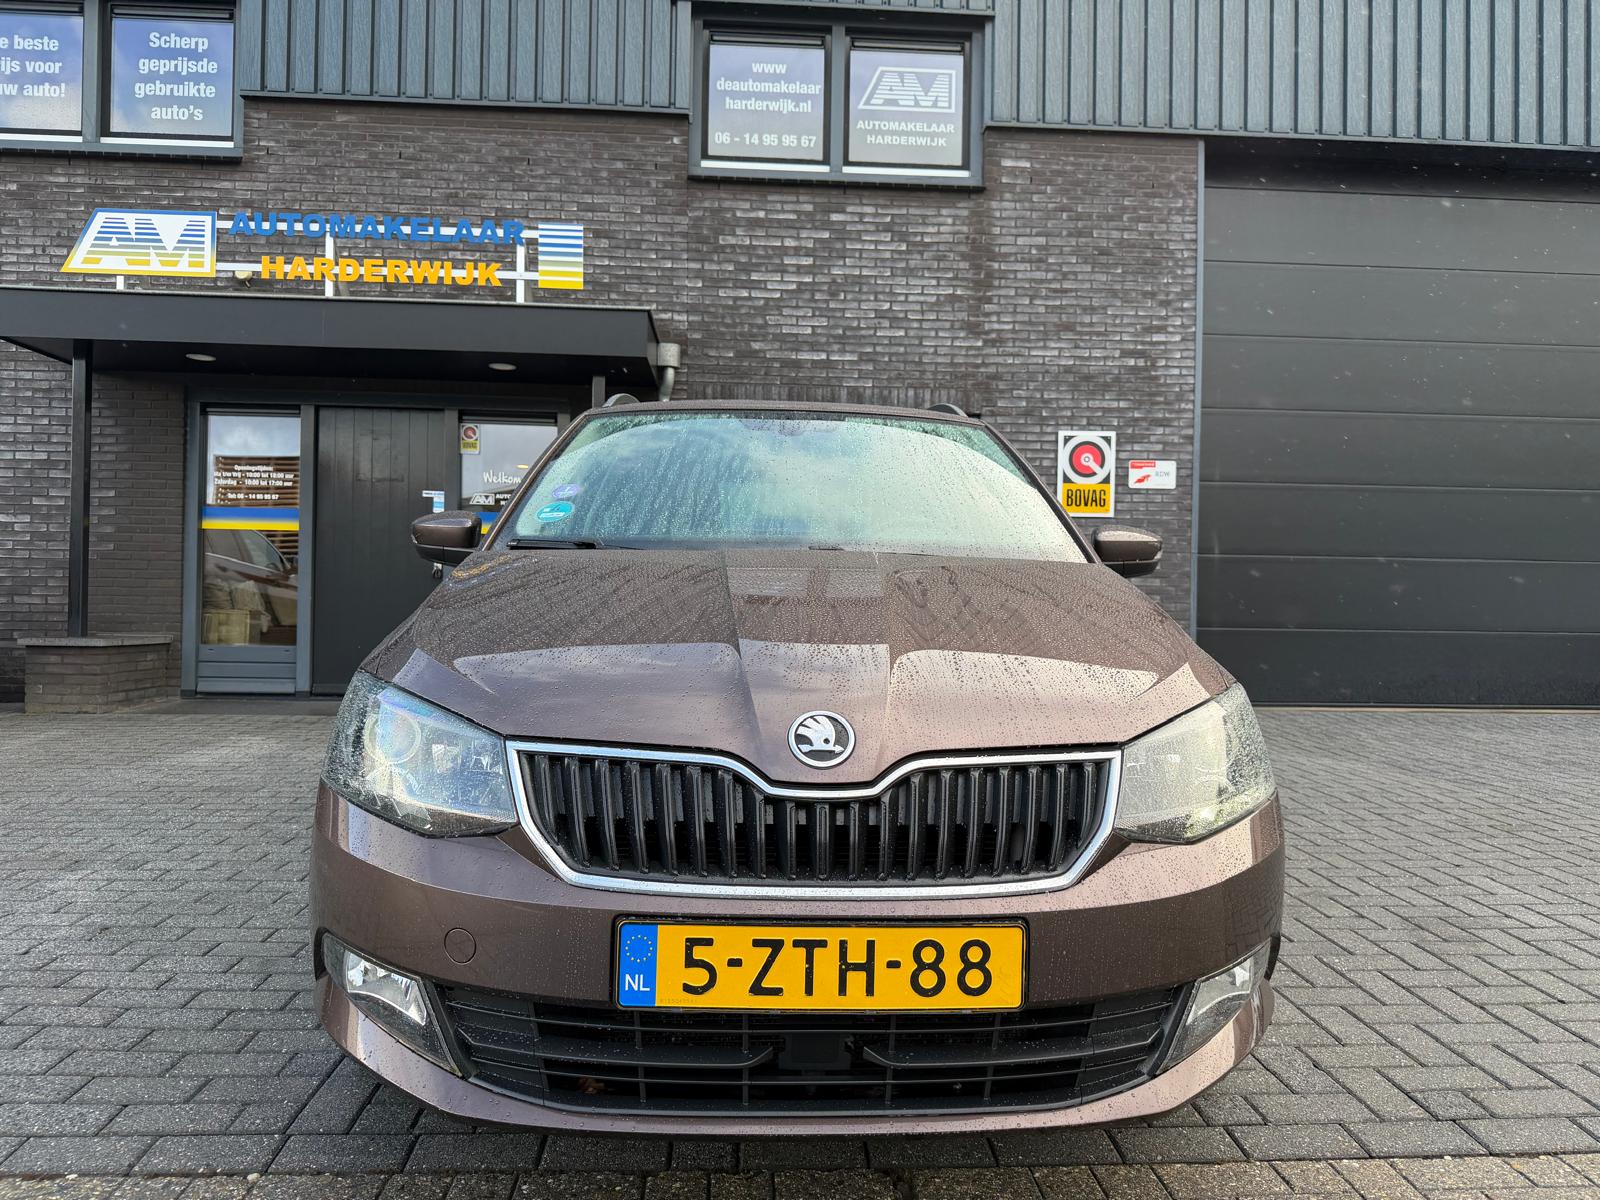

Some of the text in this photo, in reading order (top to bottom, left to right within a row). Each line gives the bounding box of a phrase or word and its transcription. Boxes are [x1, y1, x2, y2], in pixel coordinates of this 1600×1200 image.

[0, 34, 59, 51] e beste
[148, 31, 208, 53] Scherp
[0, 56, 63, 75] ijs voor
[138, 56, 218, 76] geprijsde
[751, 62, 787, 75] www
[23, 82, 66, 98] auto!
[134, 80, 216, 99] gebruikte
[716, 76, 822, 95] deautomakelaar
[150, 104, 204, 121] auto's
[725, 96, 812, 114] harderwijk.nl
[856, 119, 955, 134] AUTOMAKELAAR
[714, 131, 731, 145] 06
[744, 132, 760, 146] 14
[762, 134, 779, 147] 95
[782, 134, 798, 147] 95
[801, 136, 817, 149] 67
[866, 134, 948, 147] HARDERWIJK
[228, 212, 525, 246] AUTOMAKELAAR
[261, 255, 503, 287] HARDERWIJK
[483, 469, 522, 484] Welkom
[1066, 489, 1106, 508] BOVAG
[682, 937, 993, 998] 5-ZTH-88
[624, 973, 651, 992] NL
